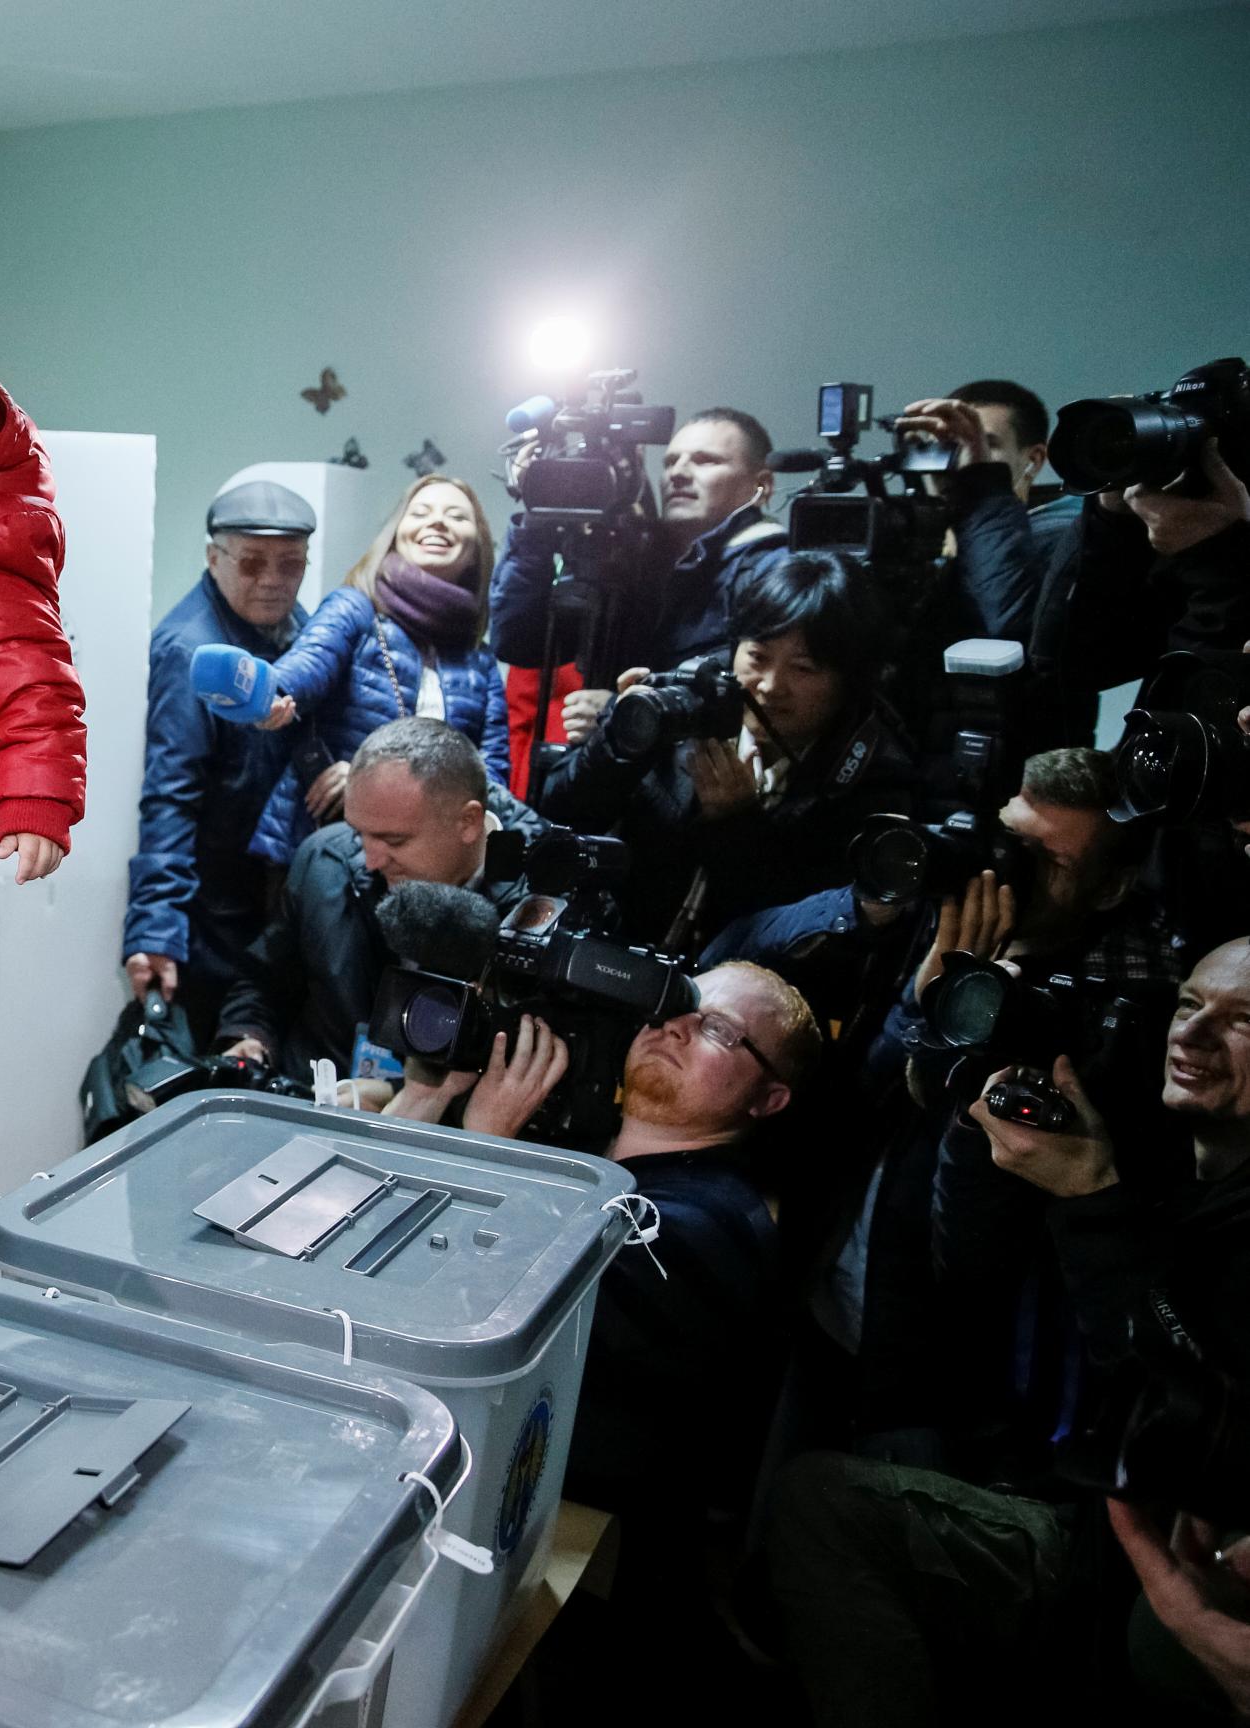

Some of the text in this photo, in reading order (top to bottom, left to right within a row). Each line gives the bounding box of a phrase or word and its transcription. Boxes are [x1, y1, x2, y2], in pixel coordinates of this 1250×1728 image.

[1175, 382, 1206, 393] Nikon
[836, 757, 859, 783] EOS
[1049, 976, 1073, 987] Canon
